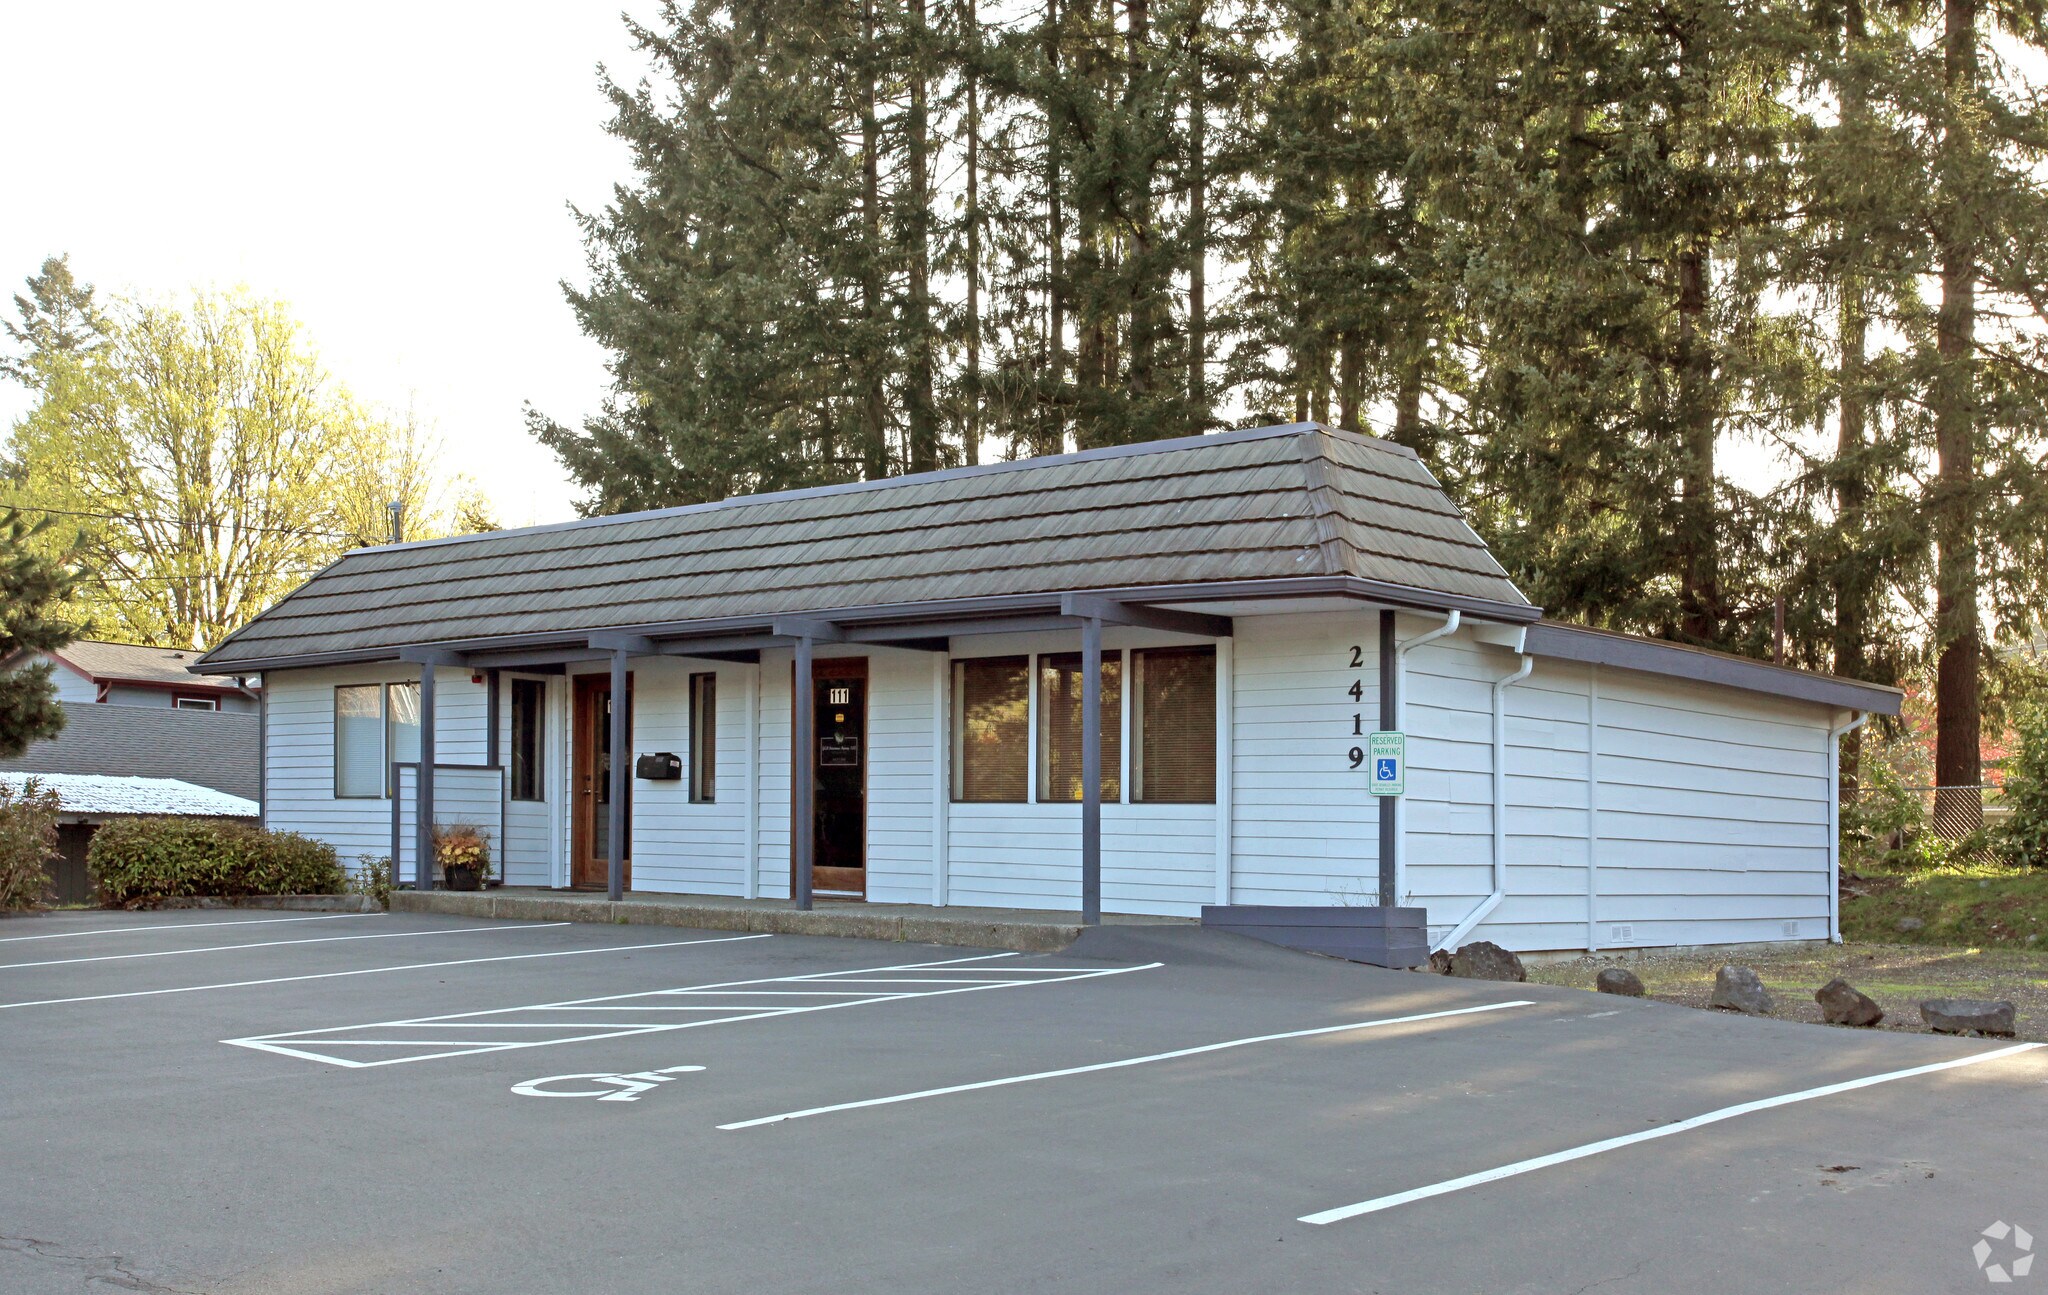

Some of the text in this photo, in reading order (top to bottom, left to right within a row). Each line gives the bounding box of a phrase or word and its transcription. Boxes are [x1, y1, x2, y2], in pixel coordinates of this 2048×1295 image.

[831, 688, 848, 703] 111
[1348, 645, 1364, 769] 2419
[1371, 736, 1403, 745] RESERVED
[1373, 747, 1401, 756] PARKING
